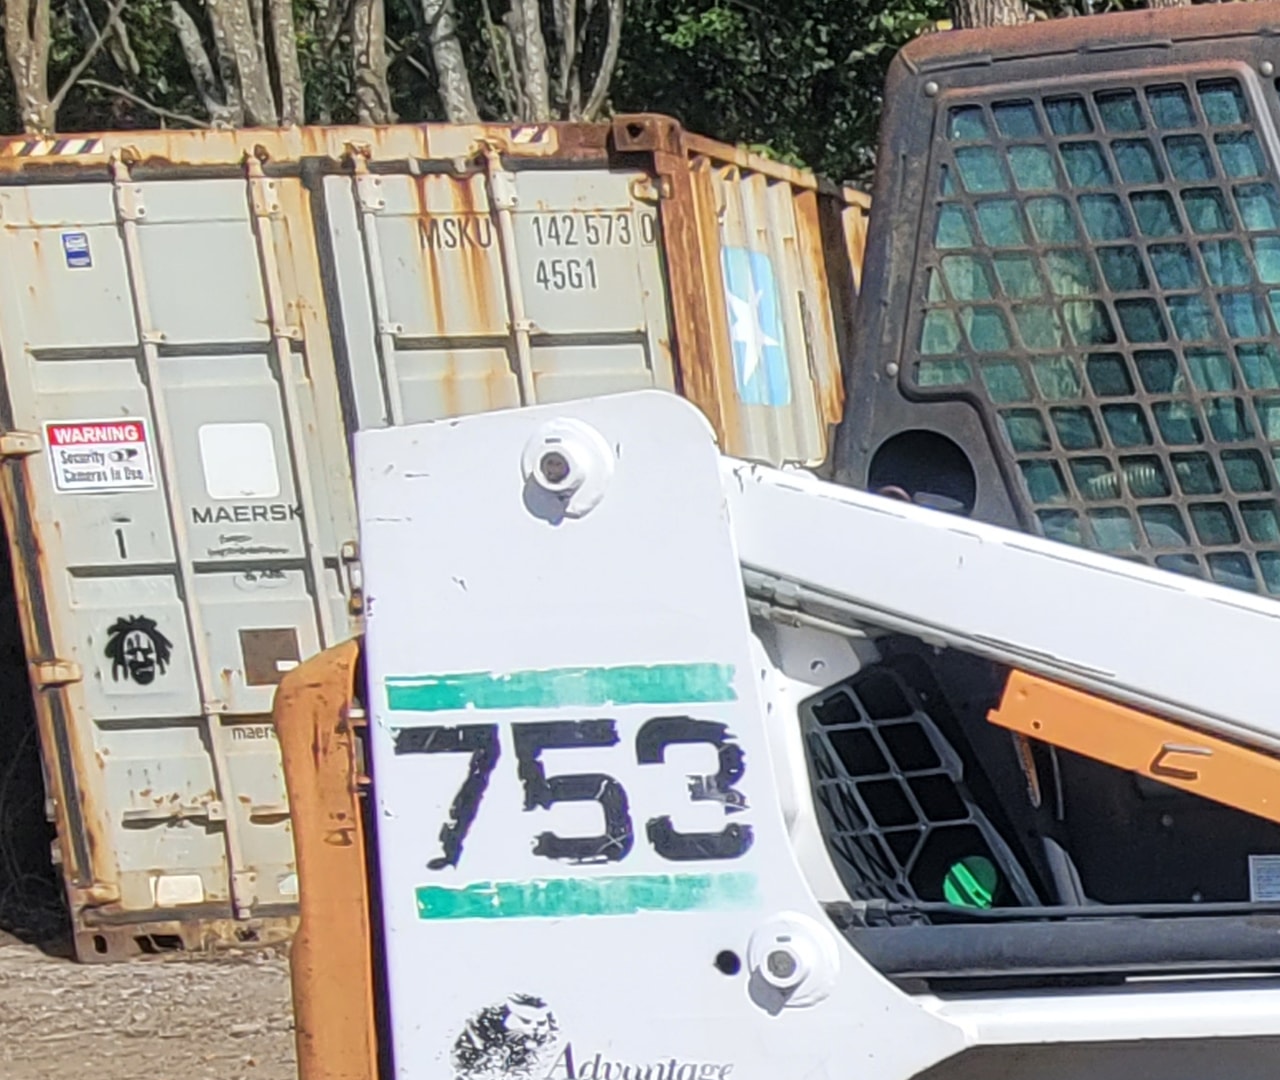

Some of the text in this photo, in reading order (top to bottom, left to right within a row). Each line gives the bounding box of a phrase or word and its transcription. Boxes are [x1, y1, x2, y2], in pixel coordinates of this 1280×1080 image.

[417, 217, 492, 249] MSKU
[532, 215, 578, 247] 142
[585, 213, 631, 246] 573
[536, 257, 597, 290] 45G1
[53, 424, 138, 444] WARNING
[60, 449, 105, 466] Security
[192, 504, 303, 524] MAERSK
[392, 716, 755, 869] 753
